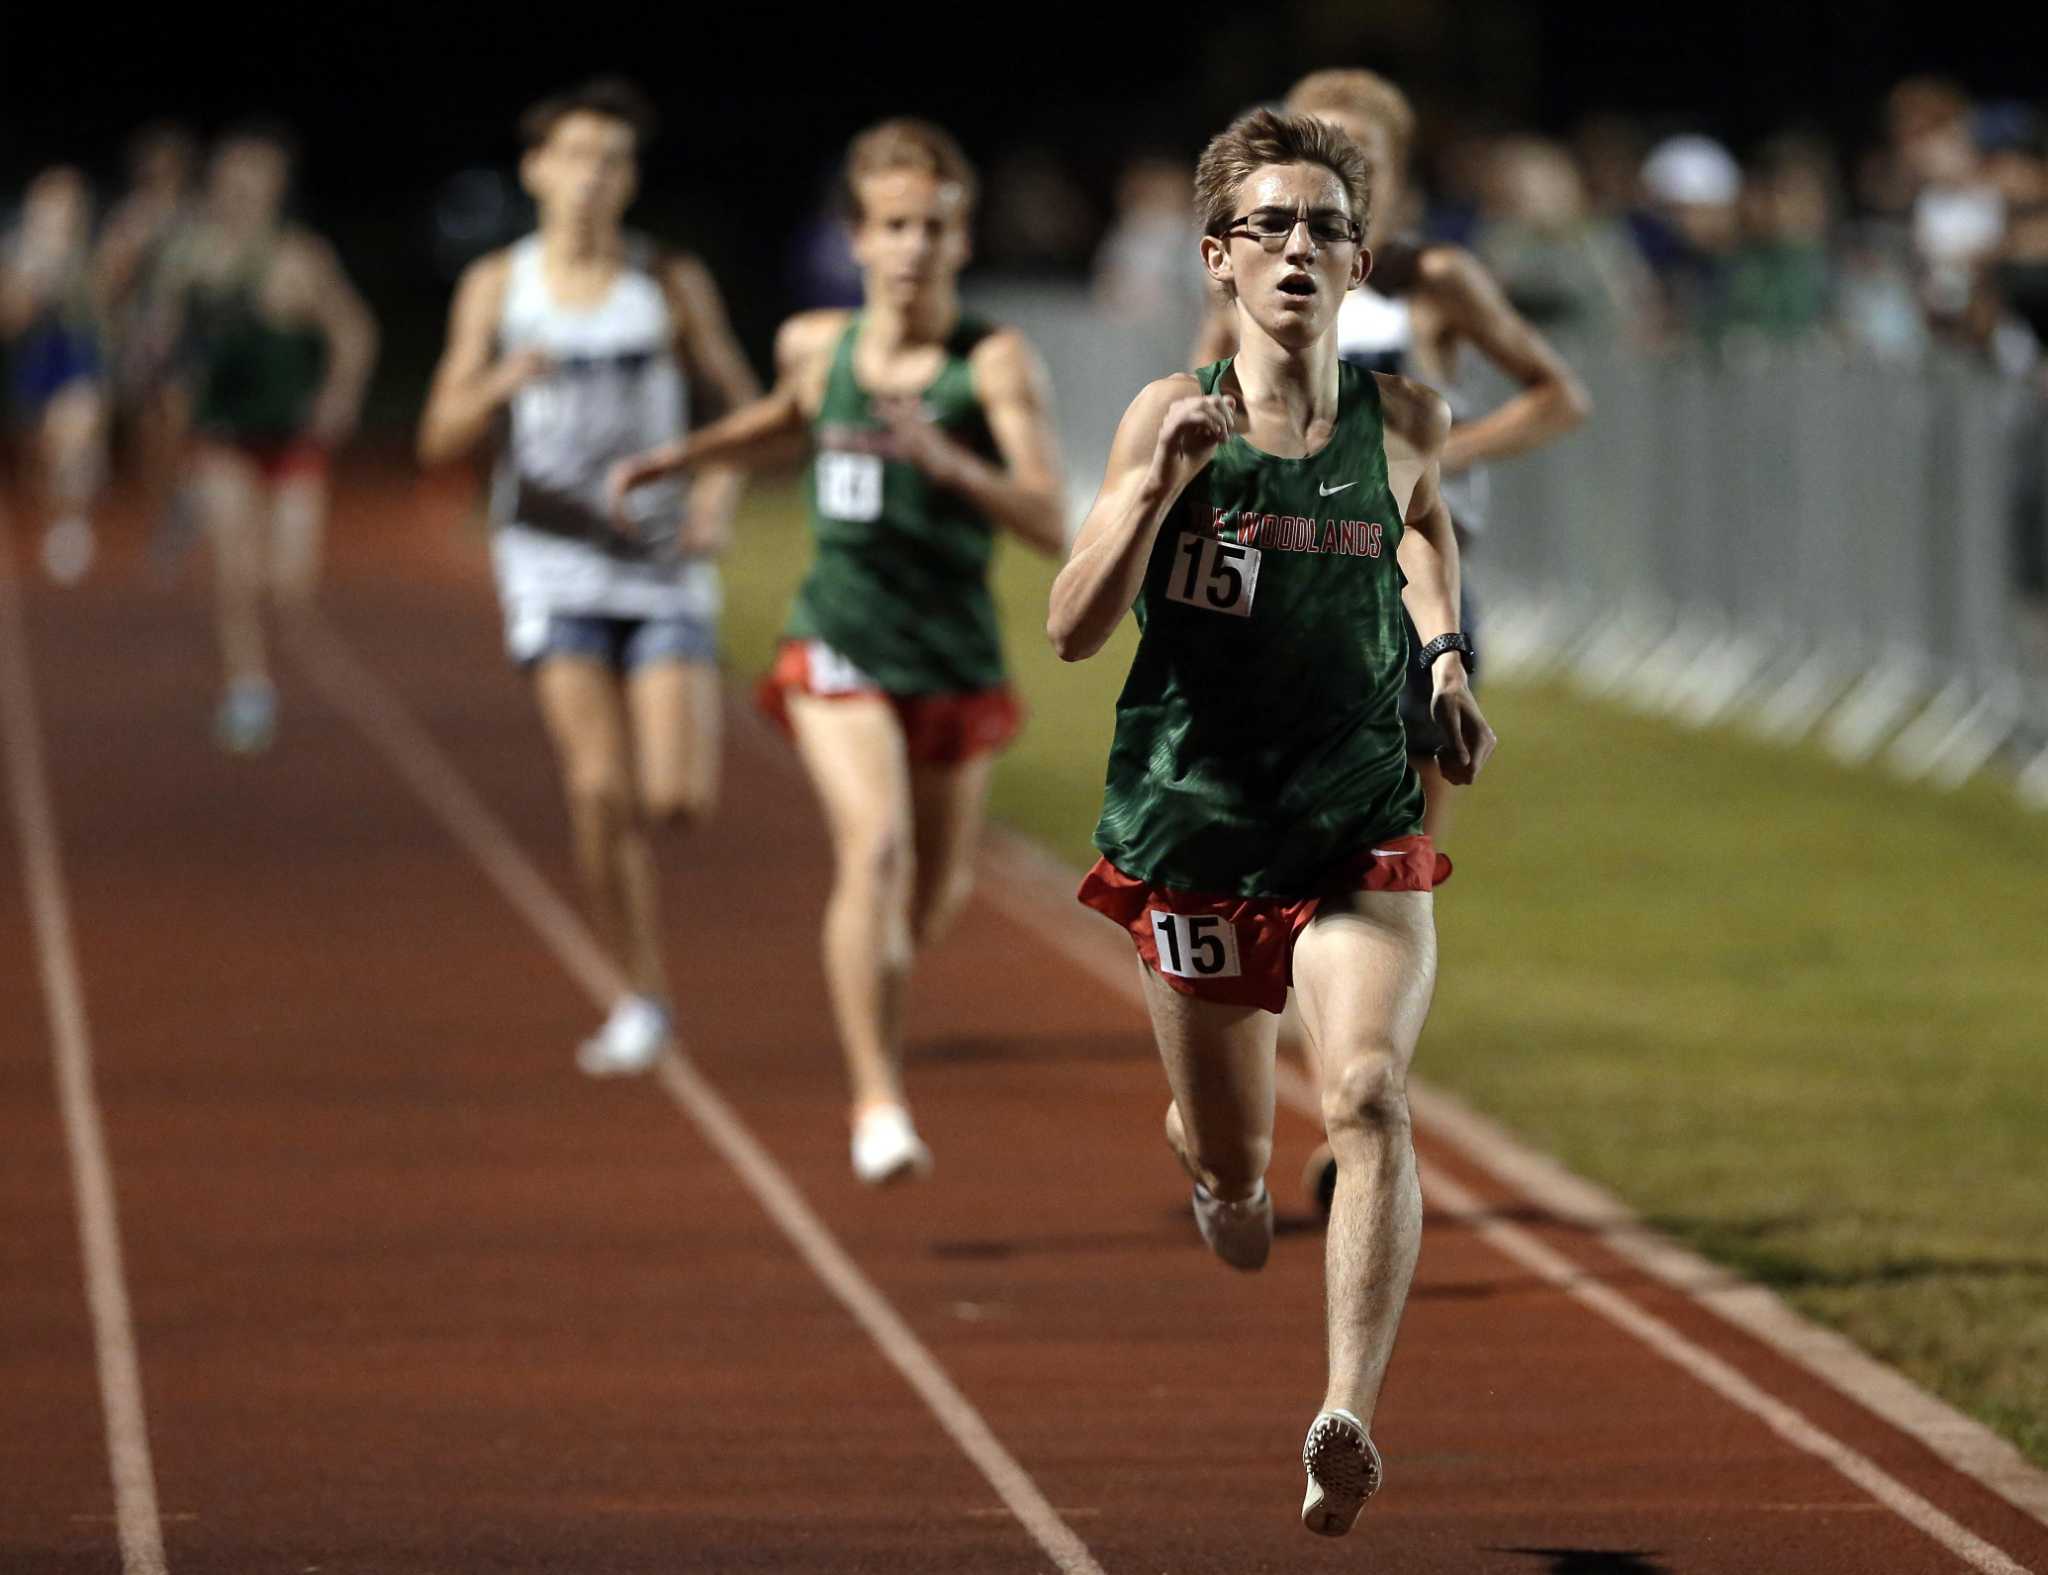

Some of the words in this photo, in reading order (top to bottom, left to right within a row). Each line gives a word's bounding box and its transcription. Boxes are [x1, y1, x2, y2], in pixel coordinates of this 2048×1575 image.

[1236, 511, 1383, 559] WOODLANDS
[1182, 537, 1246, 608] 15
[1157, 915, 1226, 974] 15
